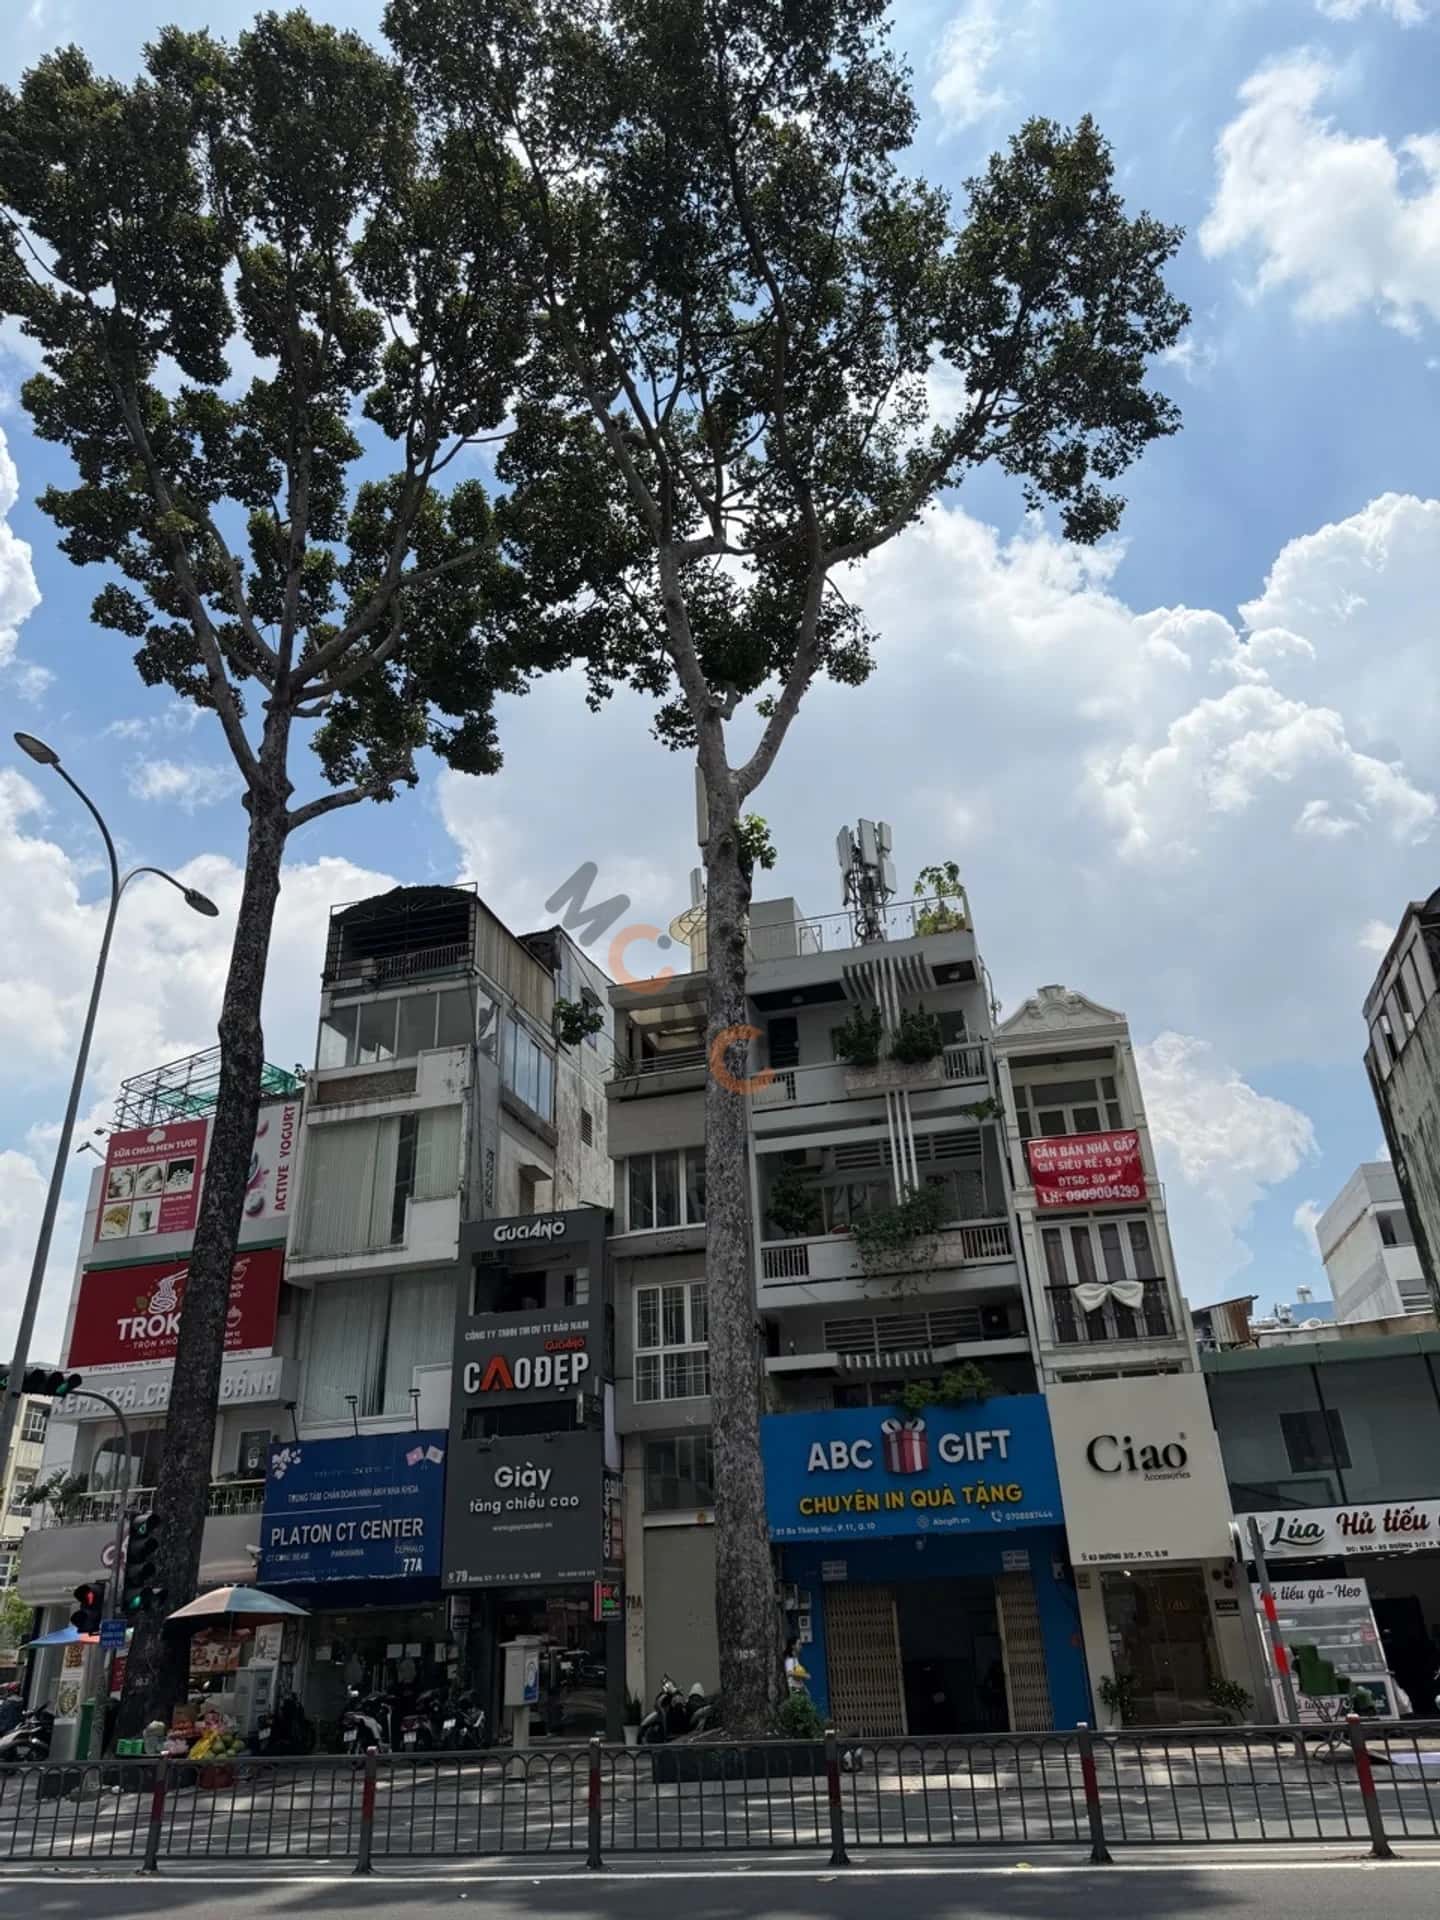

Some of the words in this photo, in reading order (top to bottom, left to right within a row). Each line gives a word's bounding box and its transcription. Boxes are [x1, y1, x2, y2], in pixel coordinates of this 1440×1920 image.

[279, 1105, 295, 1158] YOGURT
[156, 1142, 175, 1152] MEN
[1104, 1156, 1122, 1167] 9.9
[273, 1165, 289, 1211] ACTIVE
[117, 1311, 182, 1341] TROK
[487, 1330, 496, 1340] TY
[570, 1320, 590, 1330] NAM
[807, 1439, 873, 1472] ABC
[938, 1429, 1011, 1463] GIFT
[1086, 1434, 1188, 1473] Ciao
[494, 1462, 552, 1491] Giày
[469, 1496, 501, 1514] tăng
[505, 1489, 546, 1511] chiều
[550, 1494, 580, 1509] cao
[800, 1488, 879, 1516] CHUYÊN
[886, 1492, 904, 1509] IN
[961, 1480, 1022, 1510] TẶNG
[271, 1524, 332, 1546] PLATON
[335, 1520, 357, 1541] CT
[360, 1518, 423, 1541] CENTER
[1270, 1517, 1325, 1546] Lúa
[1336, 1510, 1377, 1536] Hủ
[1382, 1505, 1431, 1532] tiếu
[403, 1557, 423, 1572] 77A
[455, 1569, 468, 1583] 79
[1281, 1585, 1305, 1600] tiếu
[1307, 1587, 1324, 1604] gà
[1334, 1583, 1362, 1599] Heo
